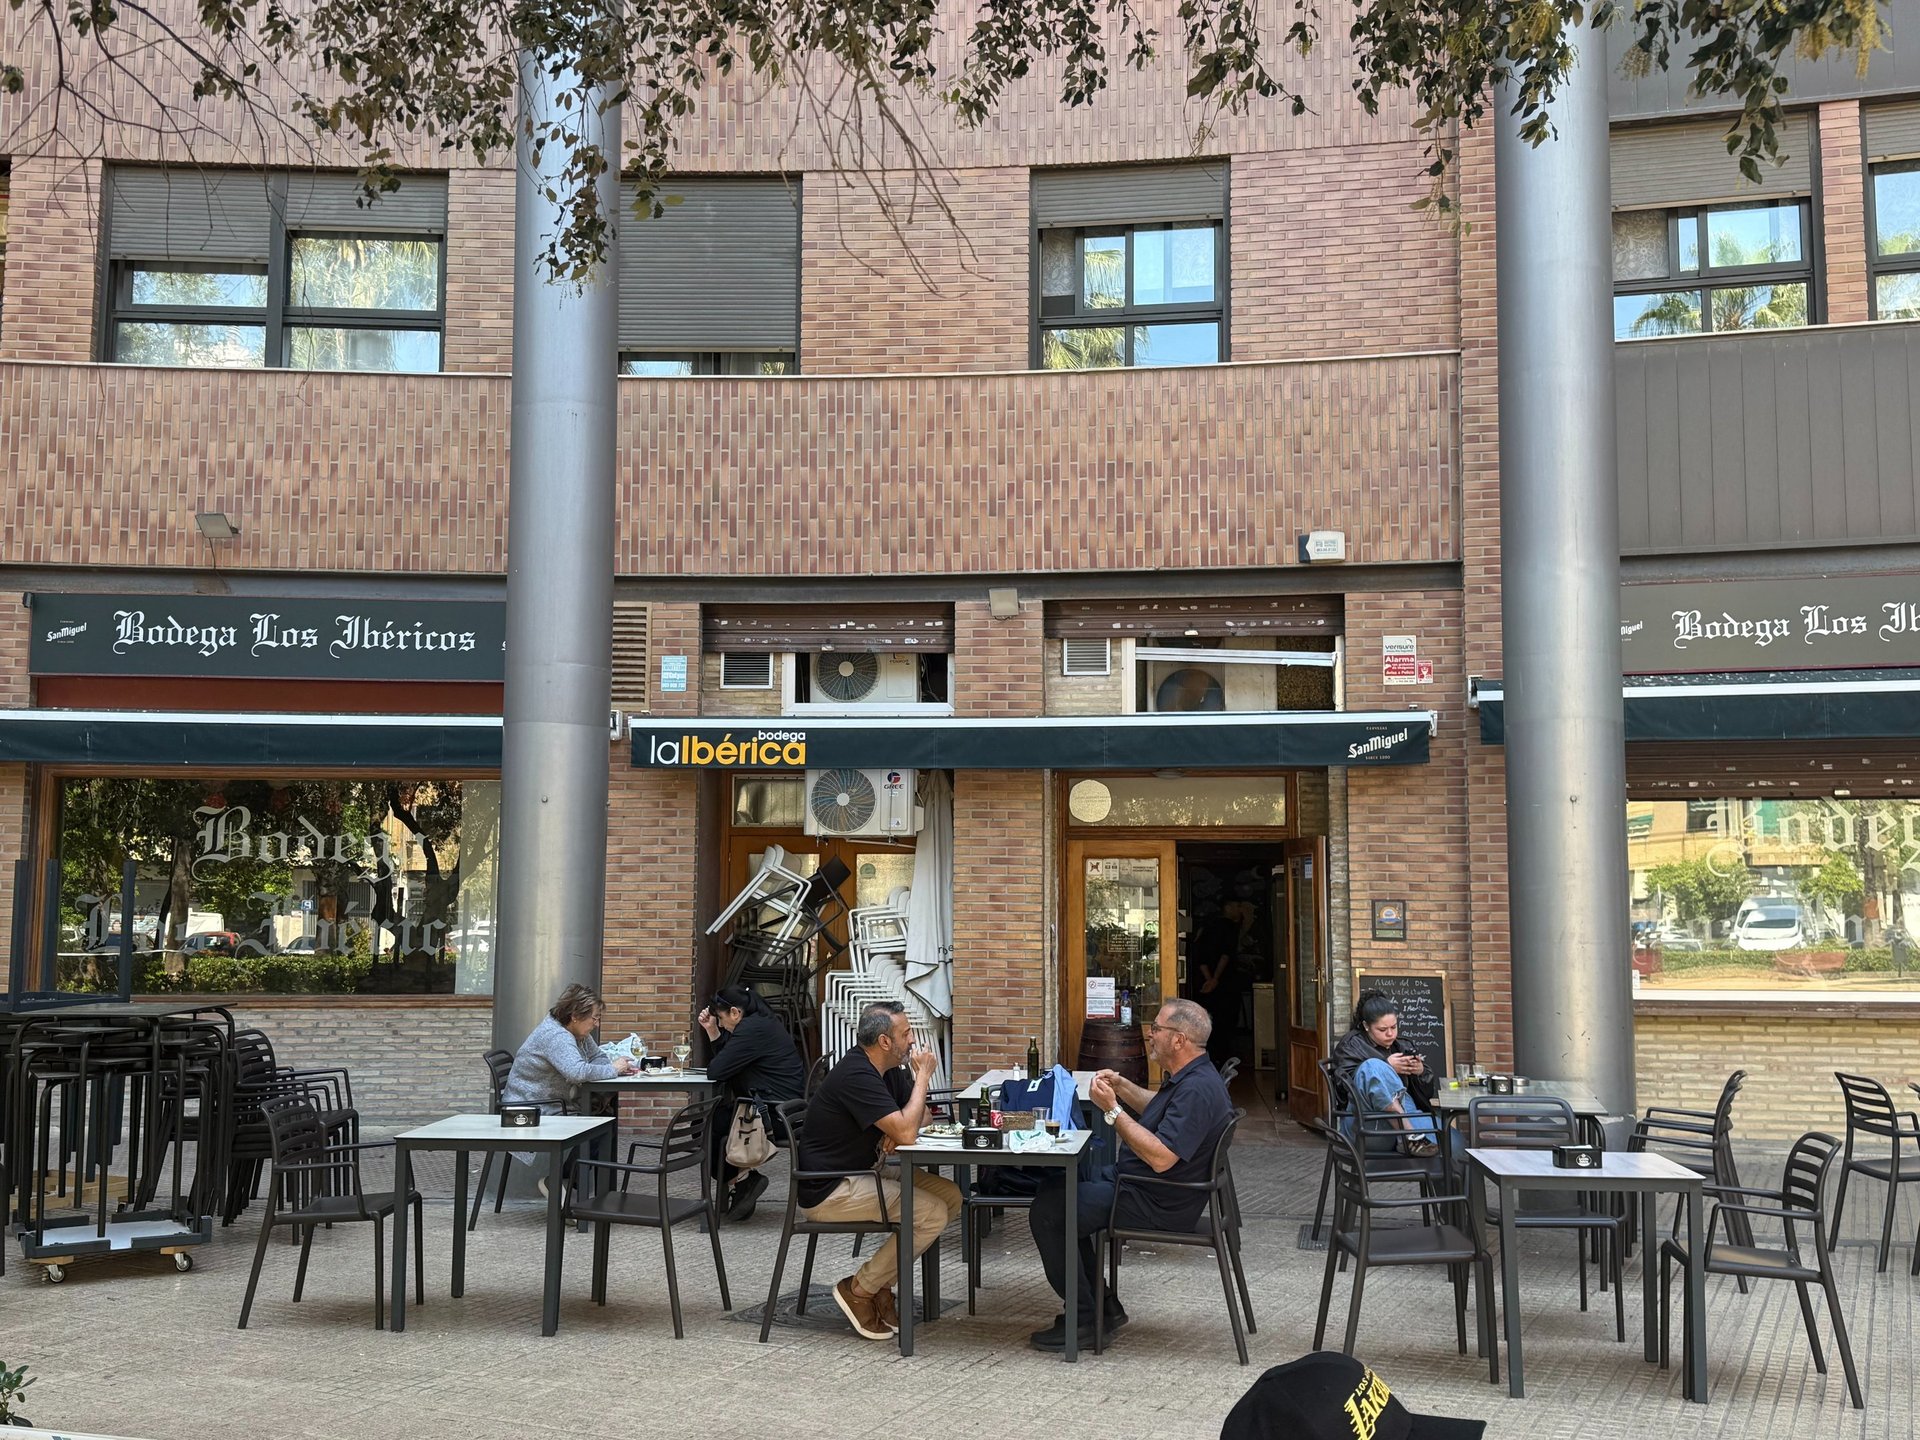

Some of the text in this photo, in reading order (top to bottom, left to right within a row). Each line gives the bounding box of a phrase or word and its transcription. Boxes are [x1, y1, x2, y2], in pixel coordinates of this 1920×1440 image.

[112, 610, 476, 659] Bodega Los Ibéricos
[1671, 609, 1791, 649] Bodega
[1800, 604, 1868, 645] Los
[1385, 655, 1415, 663] Alarma
[758, 730, 806, 743] bodega
[1355, 1376, 1369, 1397] LOS
